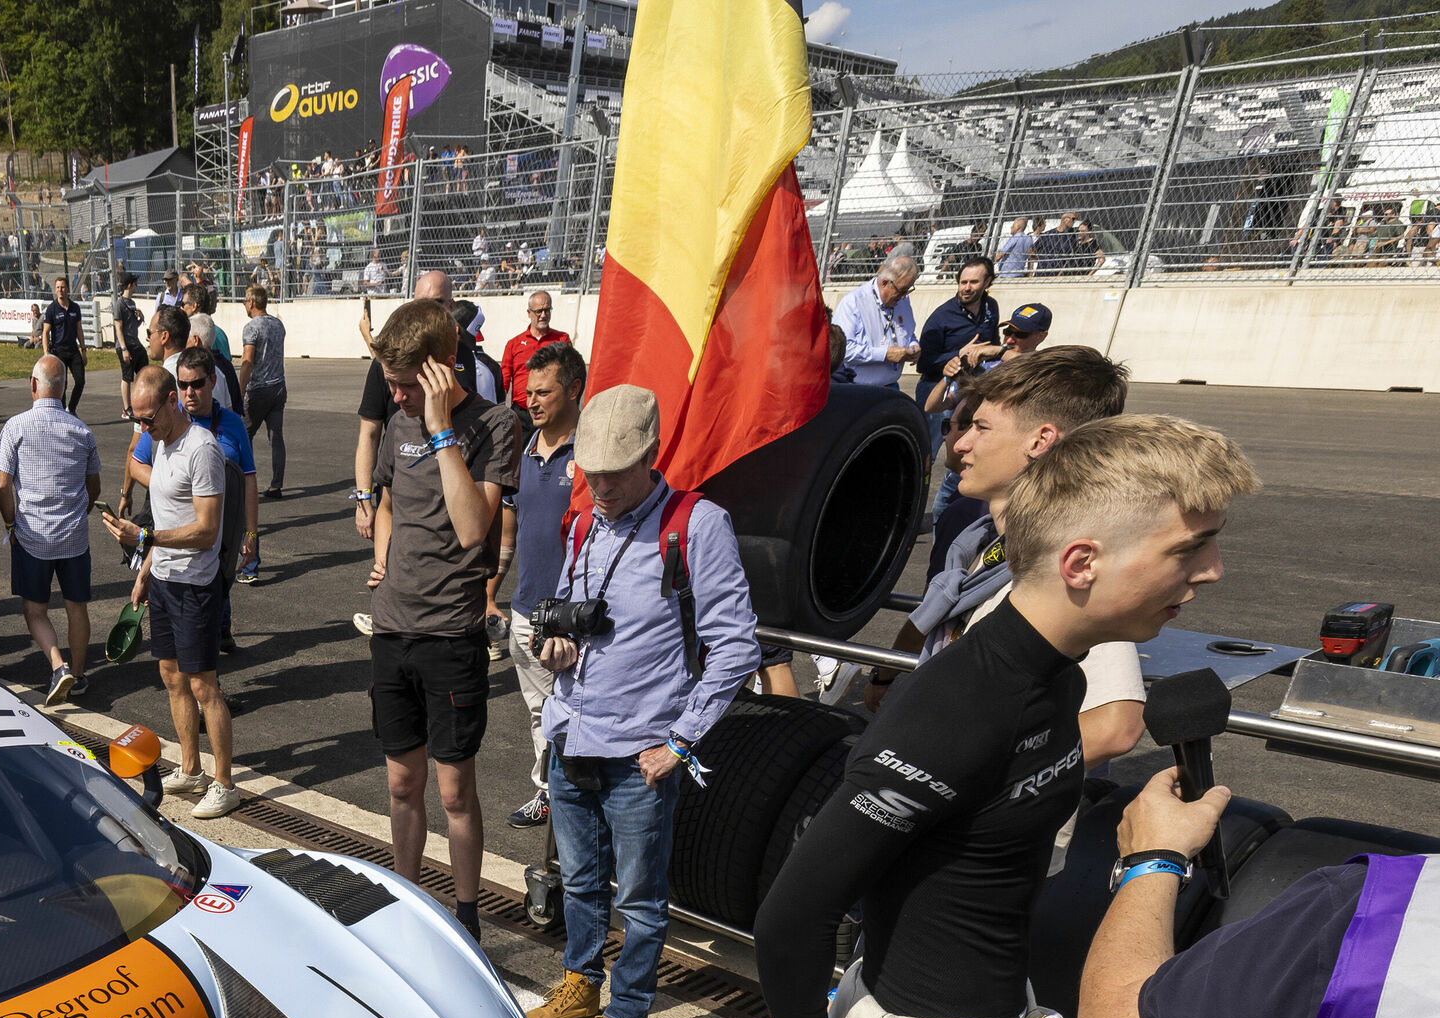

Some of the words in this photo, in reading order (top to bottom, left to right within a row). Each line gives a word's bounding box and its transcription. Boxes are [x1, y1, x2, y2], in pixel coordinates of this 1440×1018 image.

[384, 61, 439, 95] CLSSIC
[384, 96, 402, 199] CROWDSTRIKE
[117, 727, 145, 747] WRT
[873, 749, 959, 801] Snap-on
[850, 799, 911, 834] PERFORMANCE
[853, 793, 916, 831] SKECHERS
